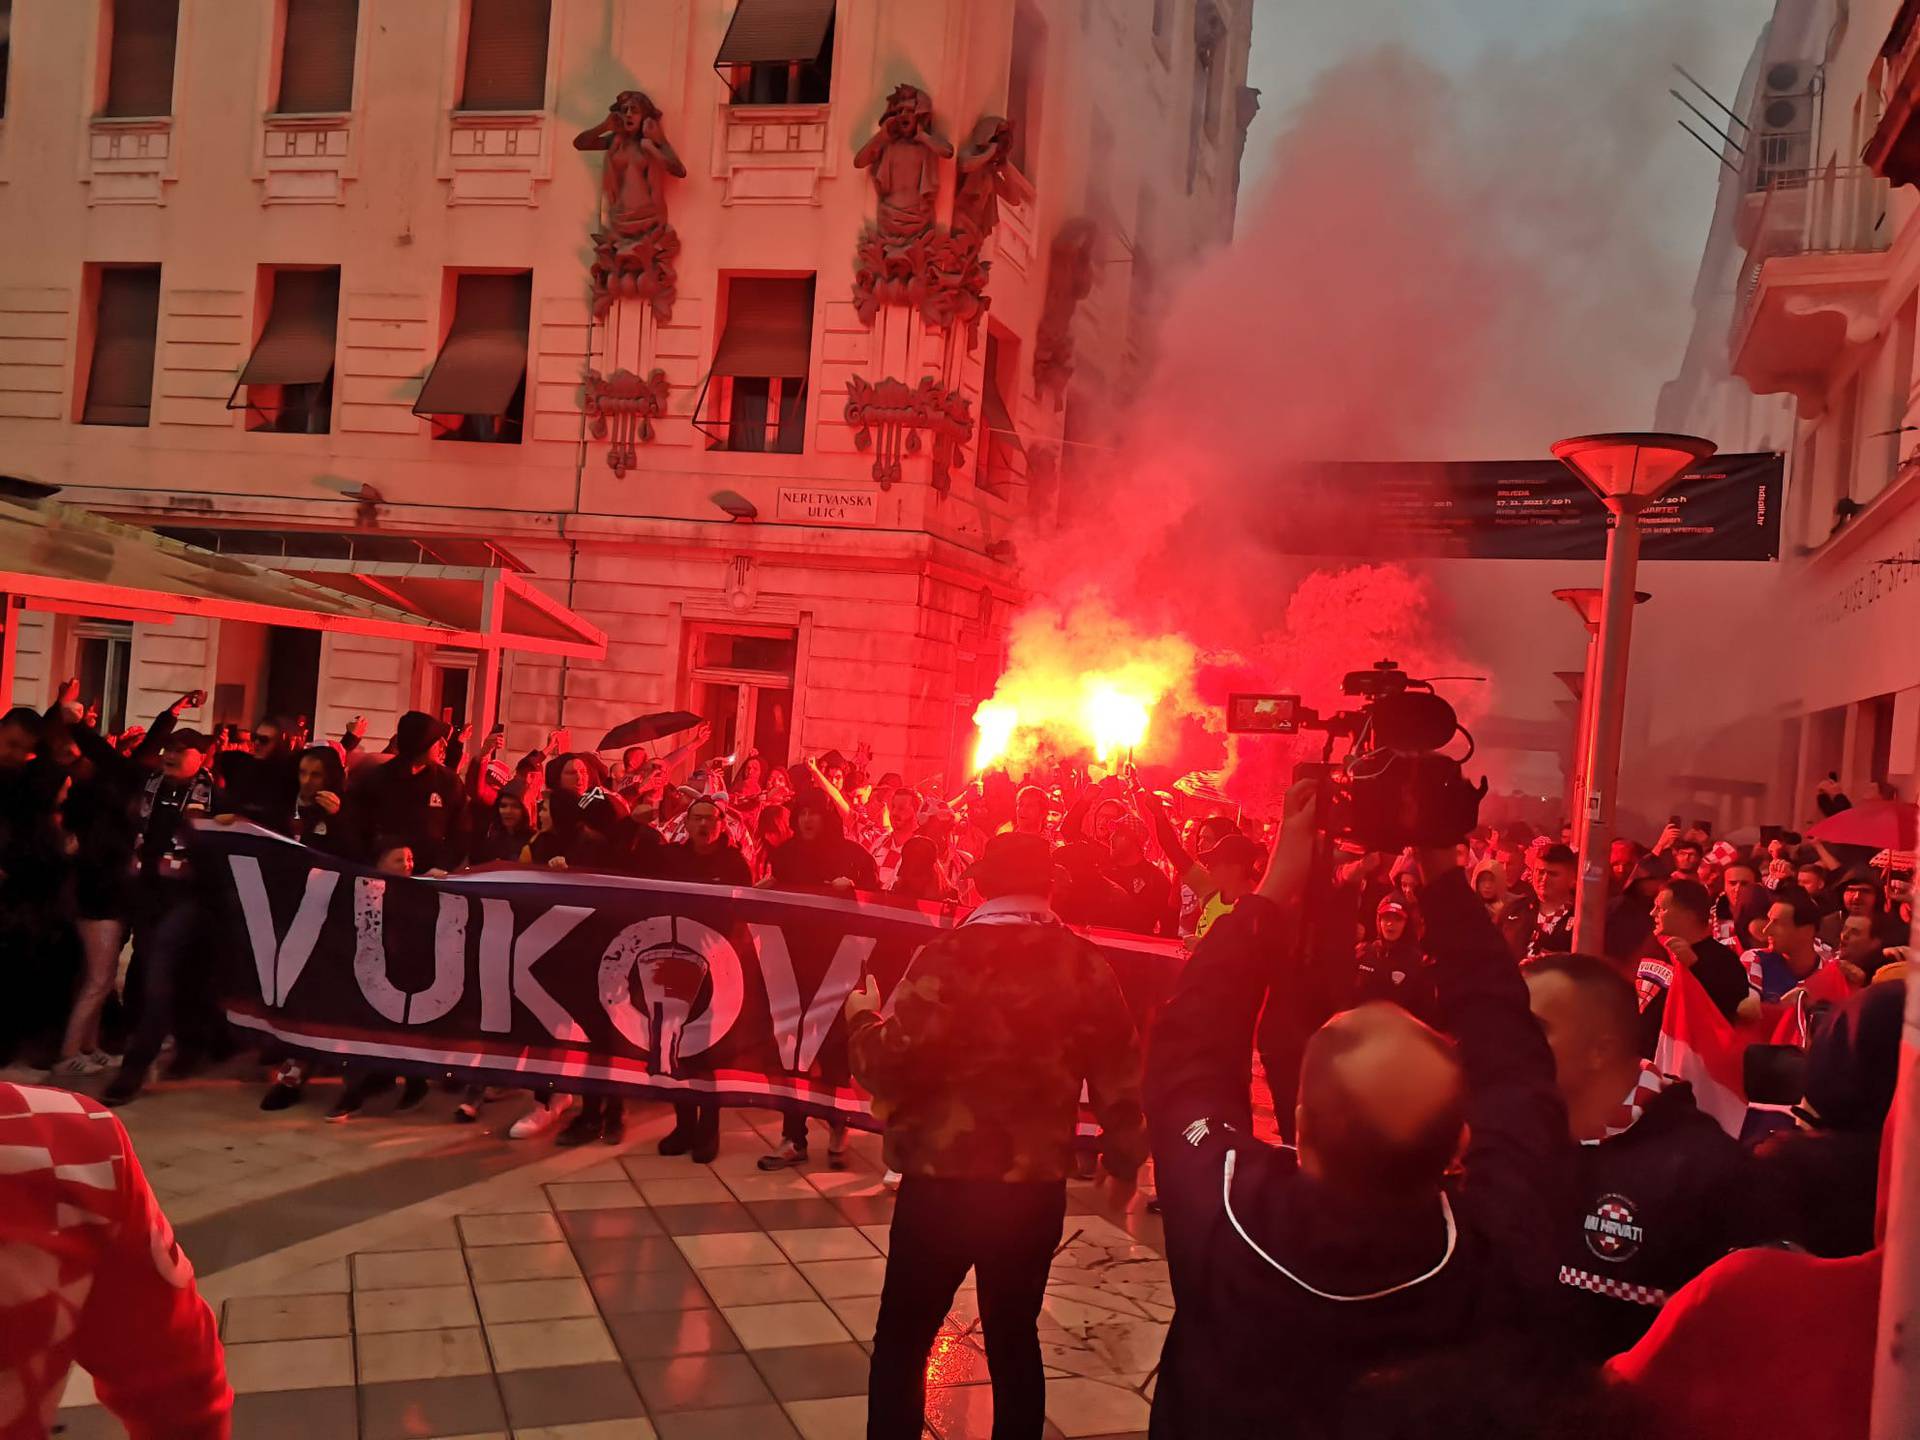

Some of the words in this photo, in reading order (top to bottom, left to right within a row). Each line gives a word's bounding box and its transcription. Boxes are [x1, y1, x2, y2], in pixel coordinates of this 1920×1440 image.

[783, 491, 873, 508] NERETVANSKA
[808, 506, 845, 519] ULICA
[228, 854, 926, 1074] VUKOV
[1599, 1217, 1644, 1244] HRVATI
